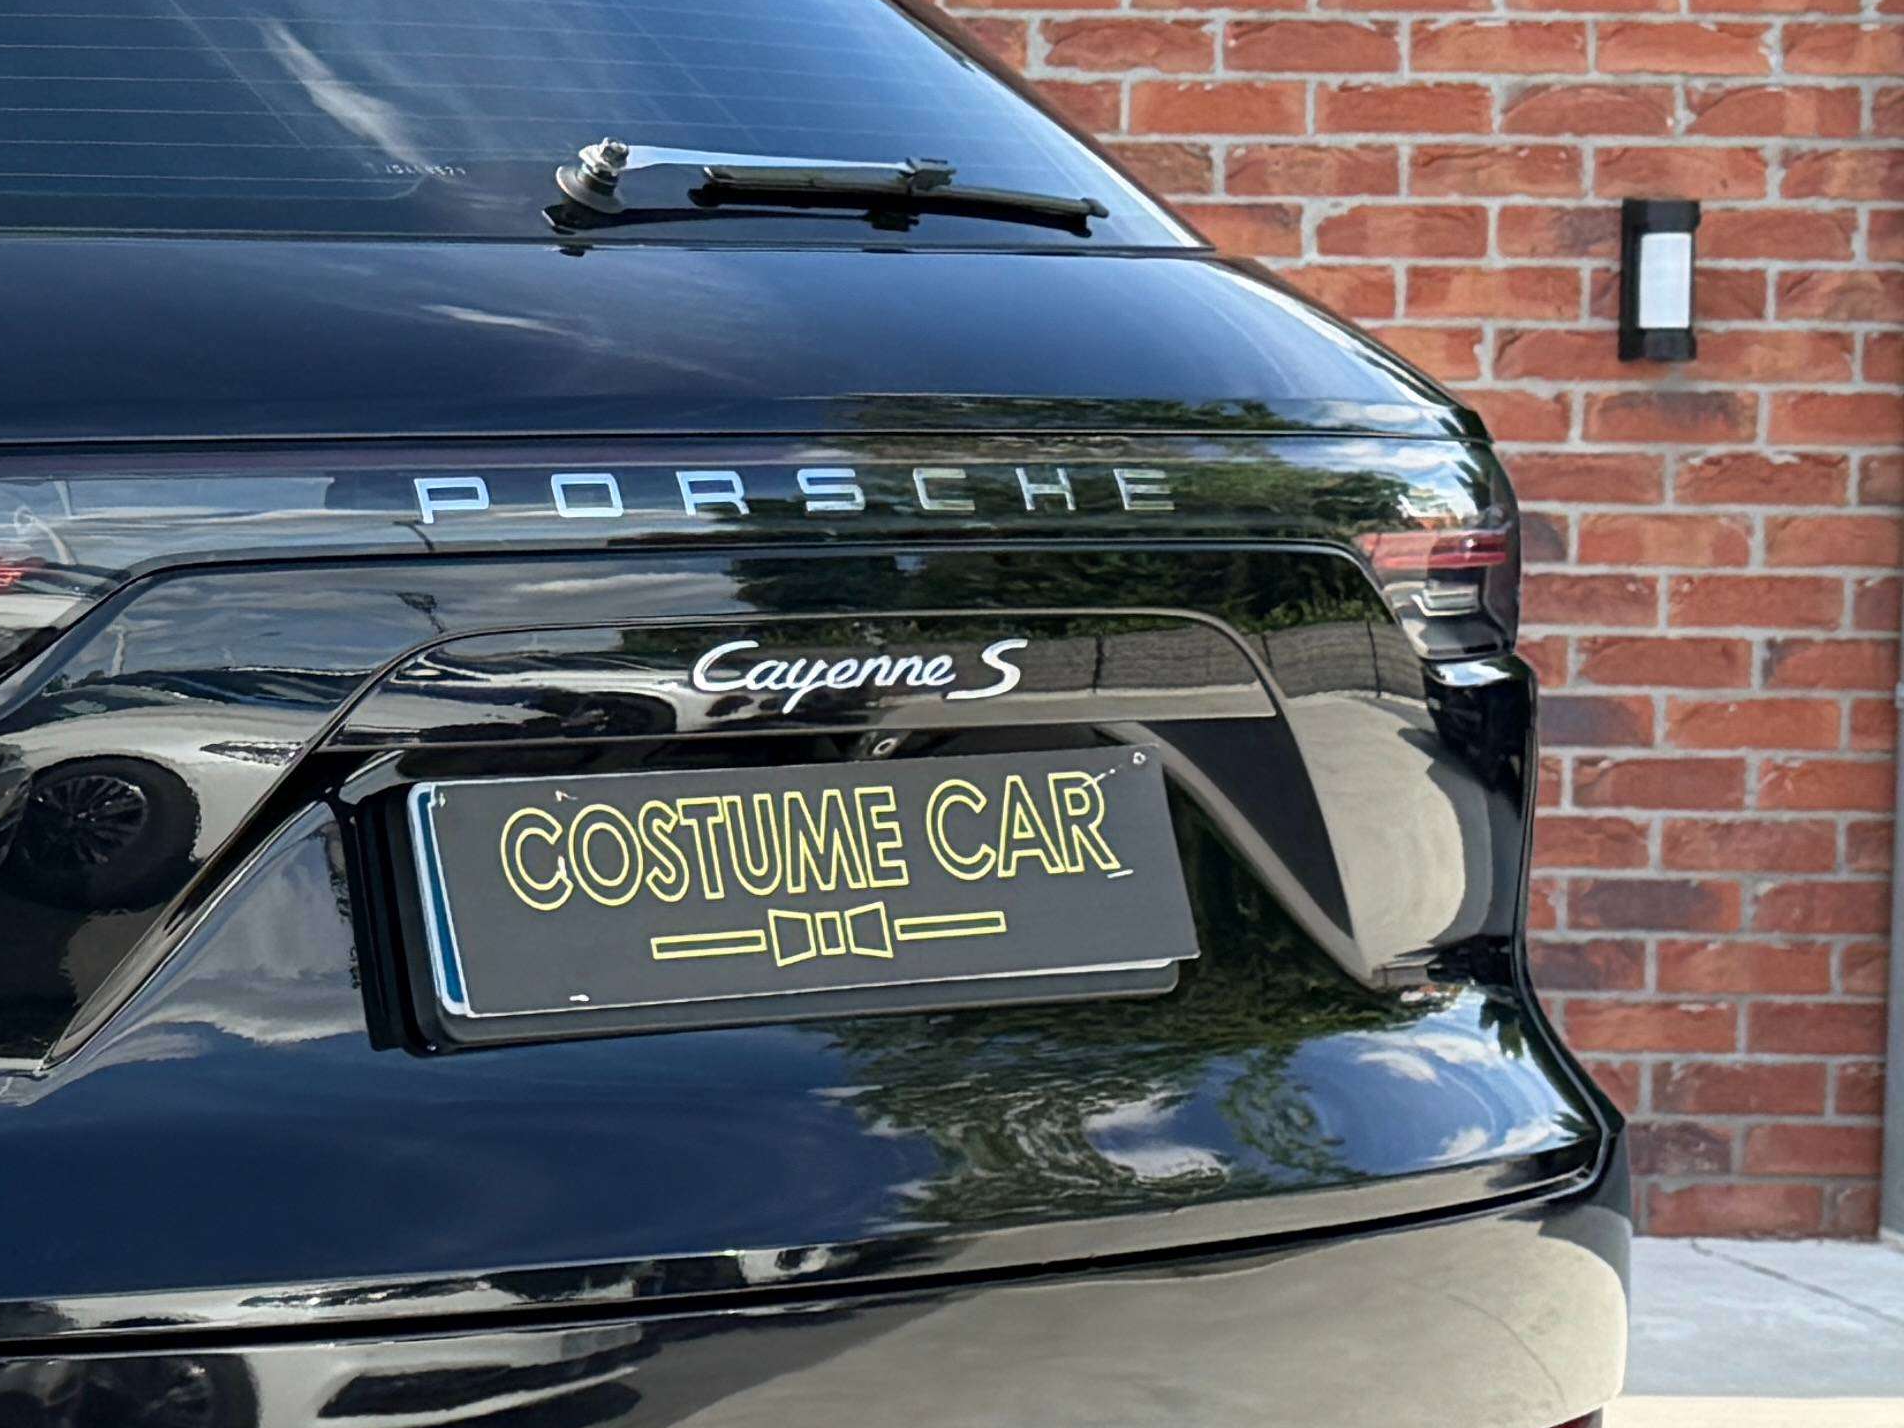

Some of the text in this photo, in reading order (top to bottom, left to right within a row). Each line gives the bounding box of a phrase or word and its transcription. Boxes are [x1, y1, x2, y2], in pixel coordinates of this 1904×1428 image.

[414, 464, 1178, 526] PORSCHE
[692, 638, 1029, 714] Cayenne S
[499, 770, 1120, 912] COSTUME CAR
